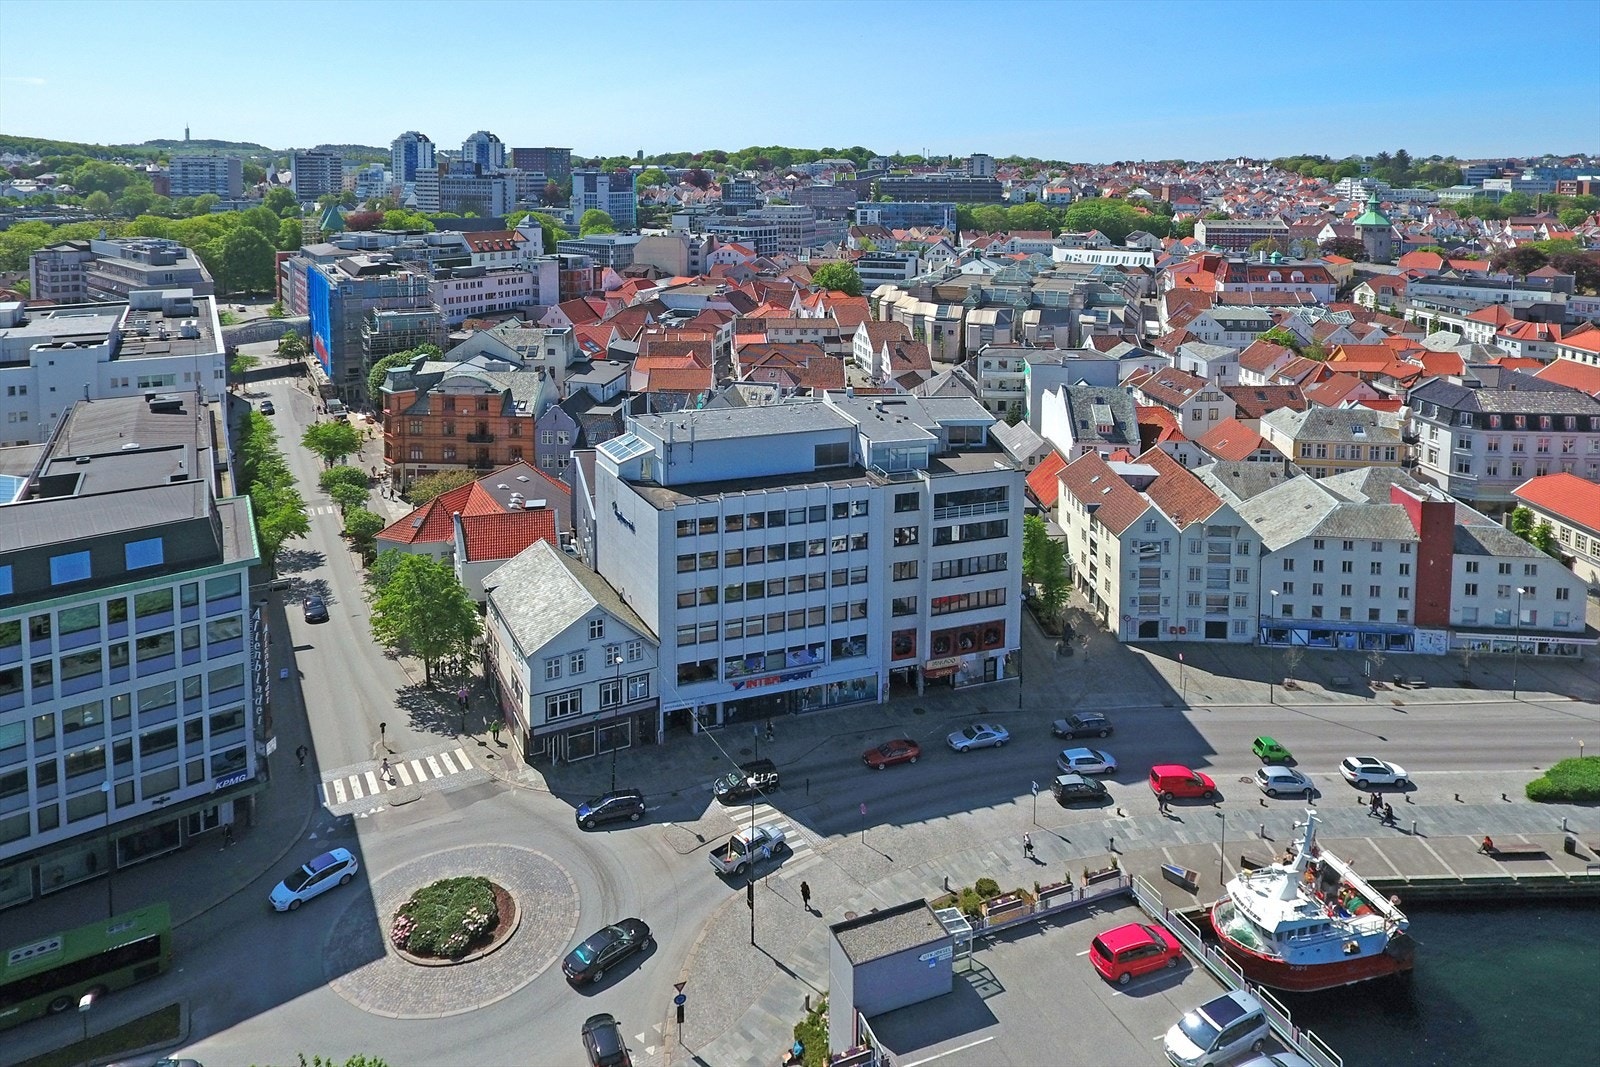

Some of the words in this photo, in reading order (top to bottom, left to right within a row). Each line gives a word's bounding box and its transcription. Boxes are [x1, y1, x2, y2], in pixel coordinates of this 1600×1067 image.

[252, 607, 262, 725] Aftenbladet
[745, 670, 813, 689] INTERSPORT
[215, 773, 247, 789] KPMG
